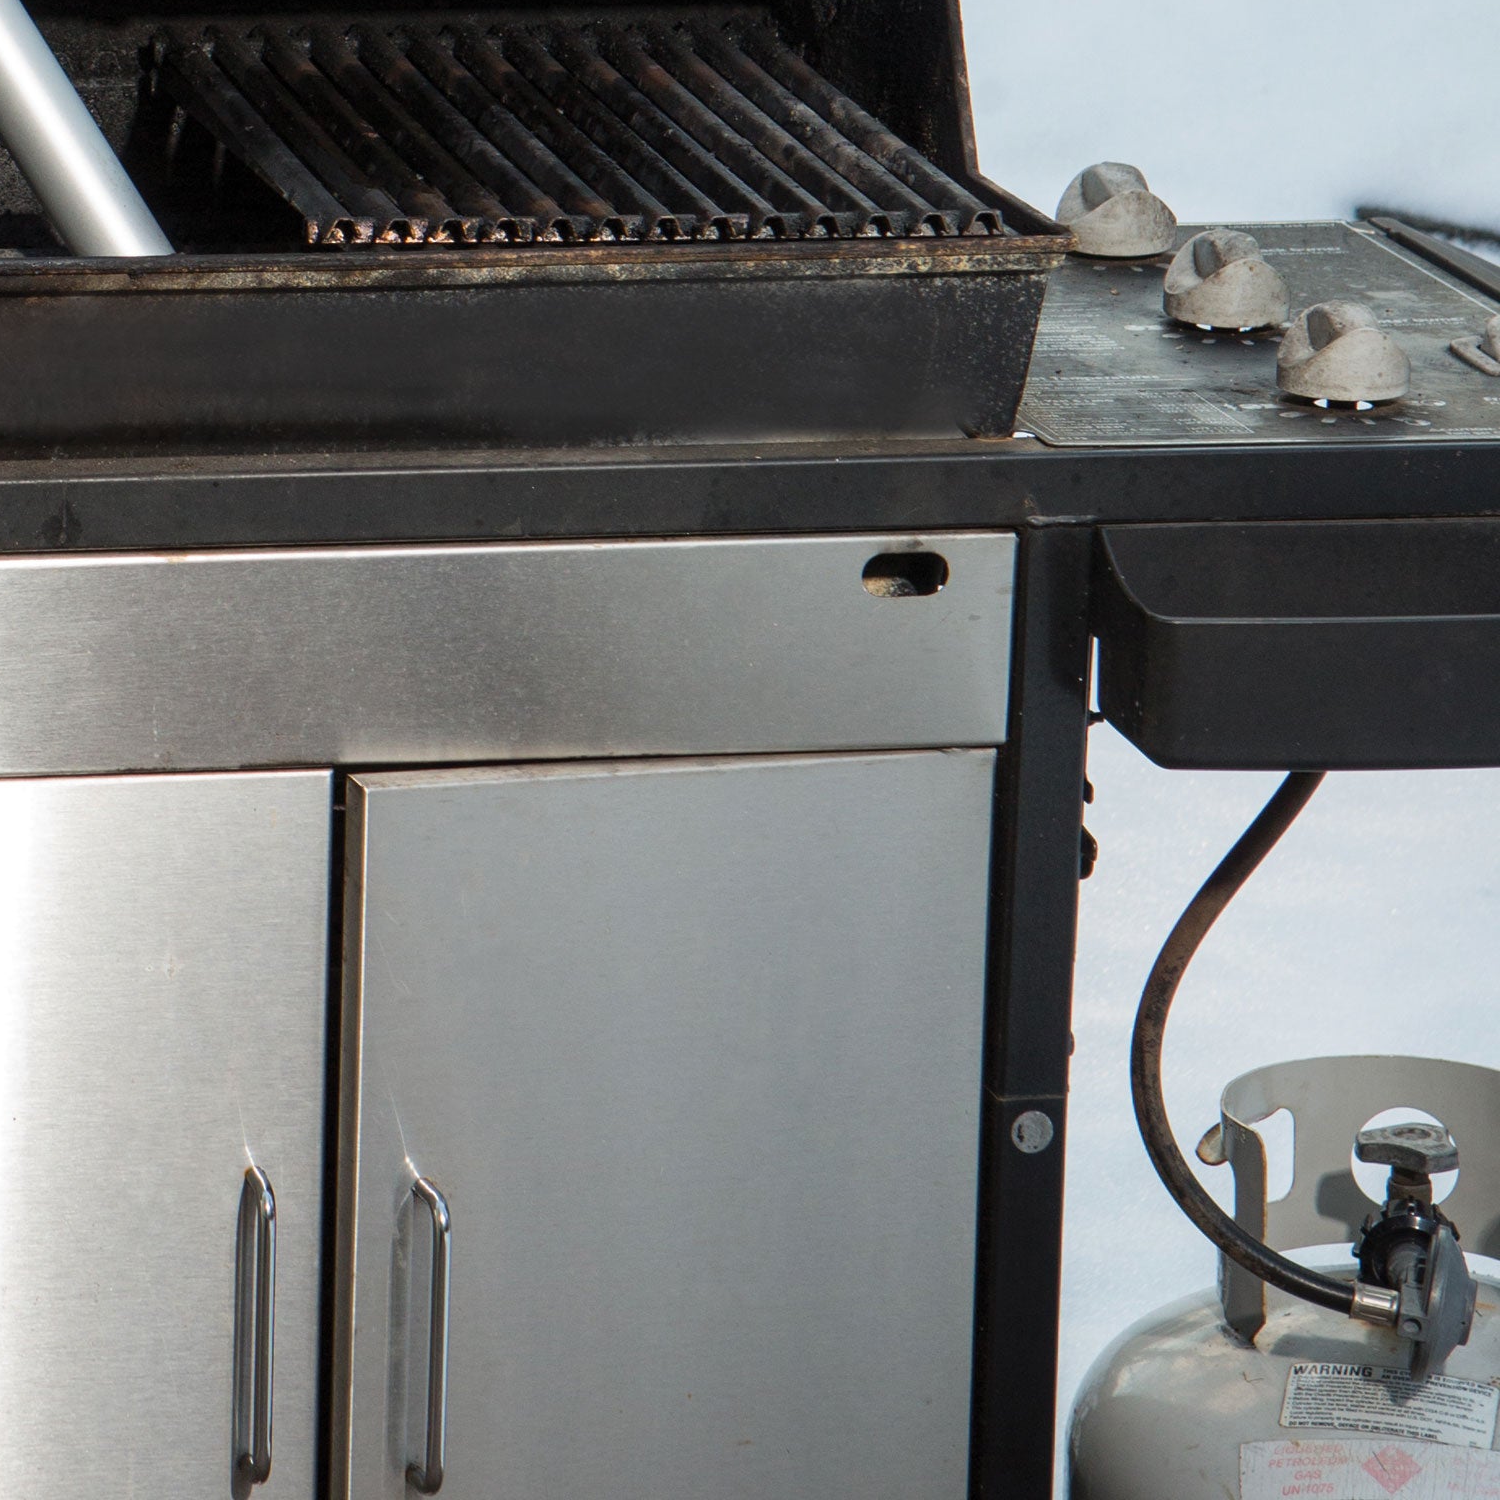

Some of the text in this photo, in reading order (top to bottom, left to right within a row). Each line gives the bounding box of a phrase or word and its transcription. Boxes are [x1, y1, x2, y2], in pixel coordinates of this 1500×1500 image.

[1293, 1365, 1373, 1377] WARNING
[1267, 1456, 1348, 1468] PETROLEUM
[1294, 1469, 1322, 1481] GAS
[1282, 1482, 1335, 1497] UN 1075
